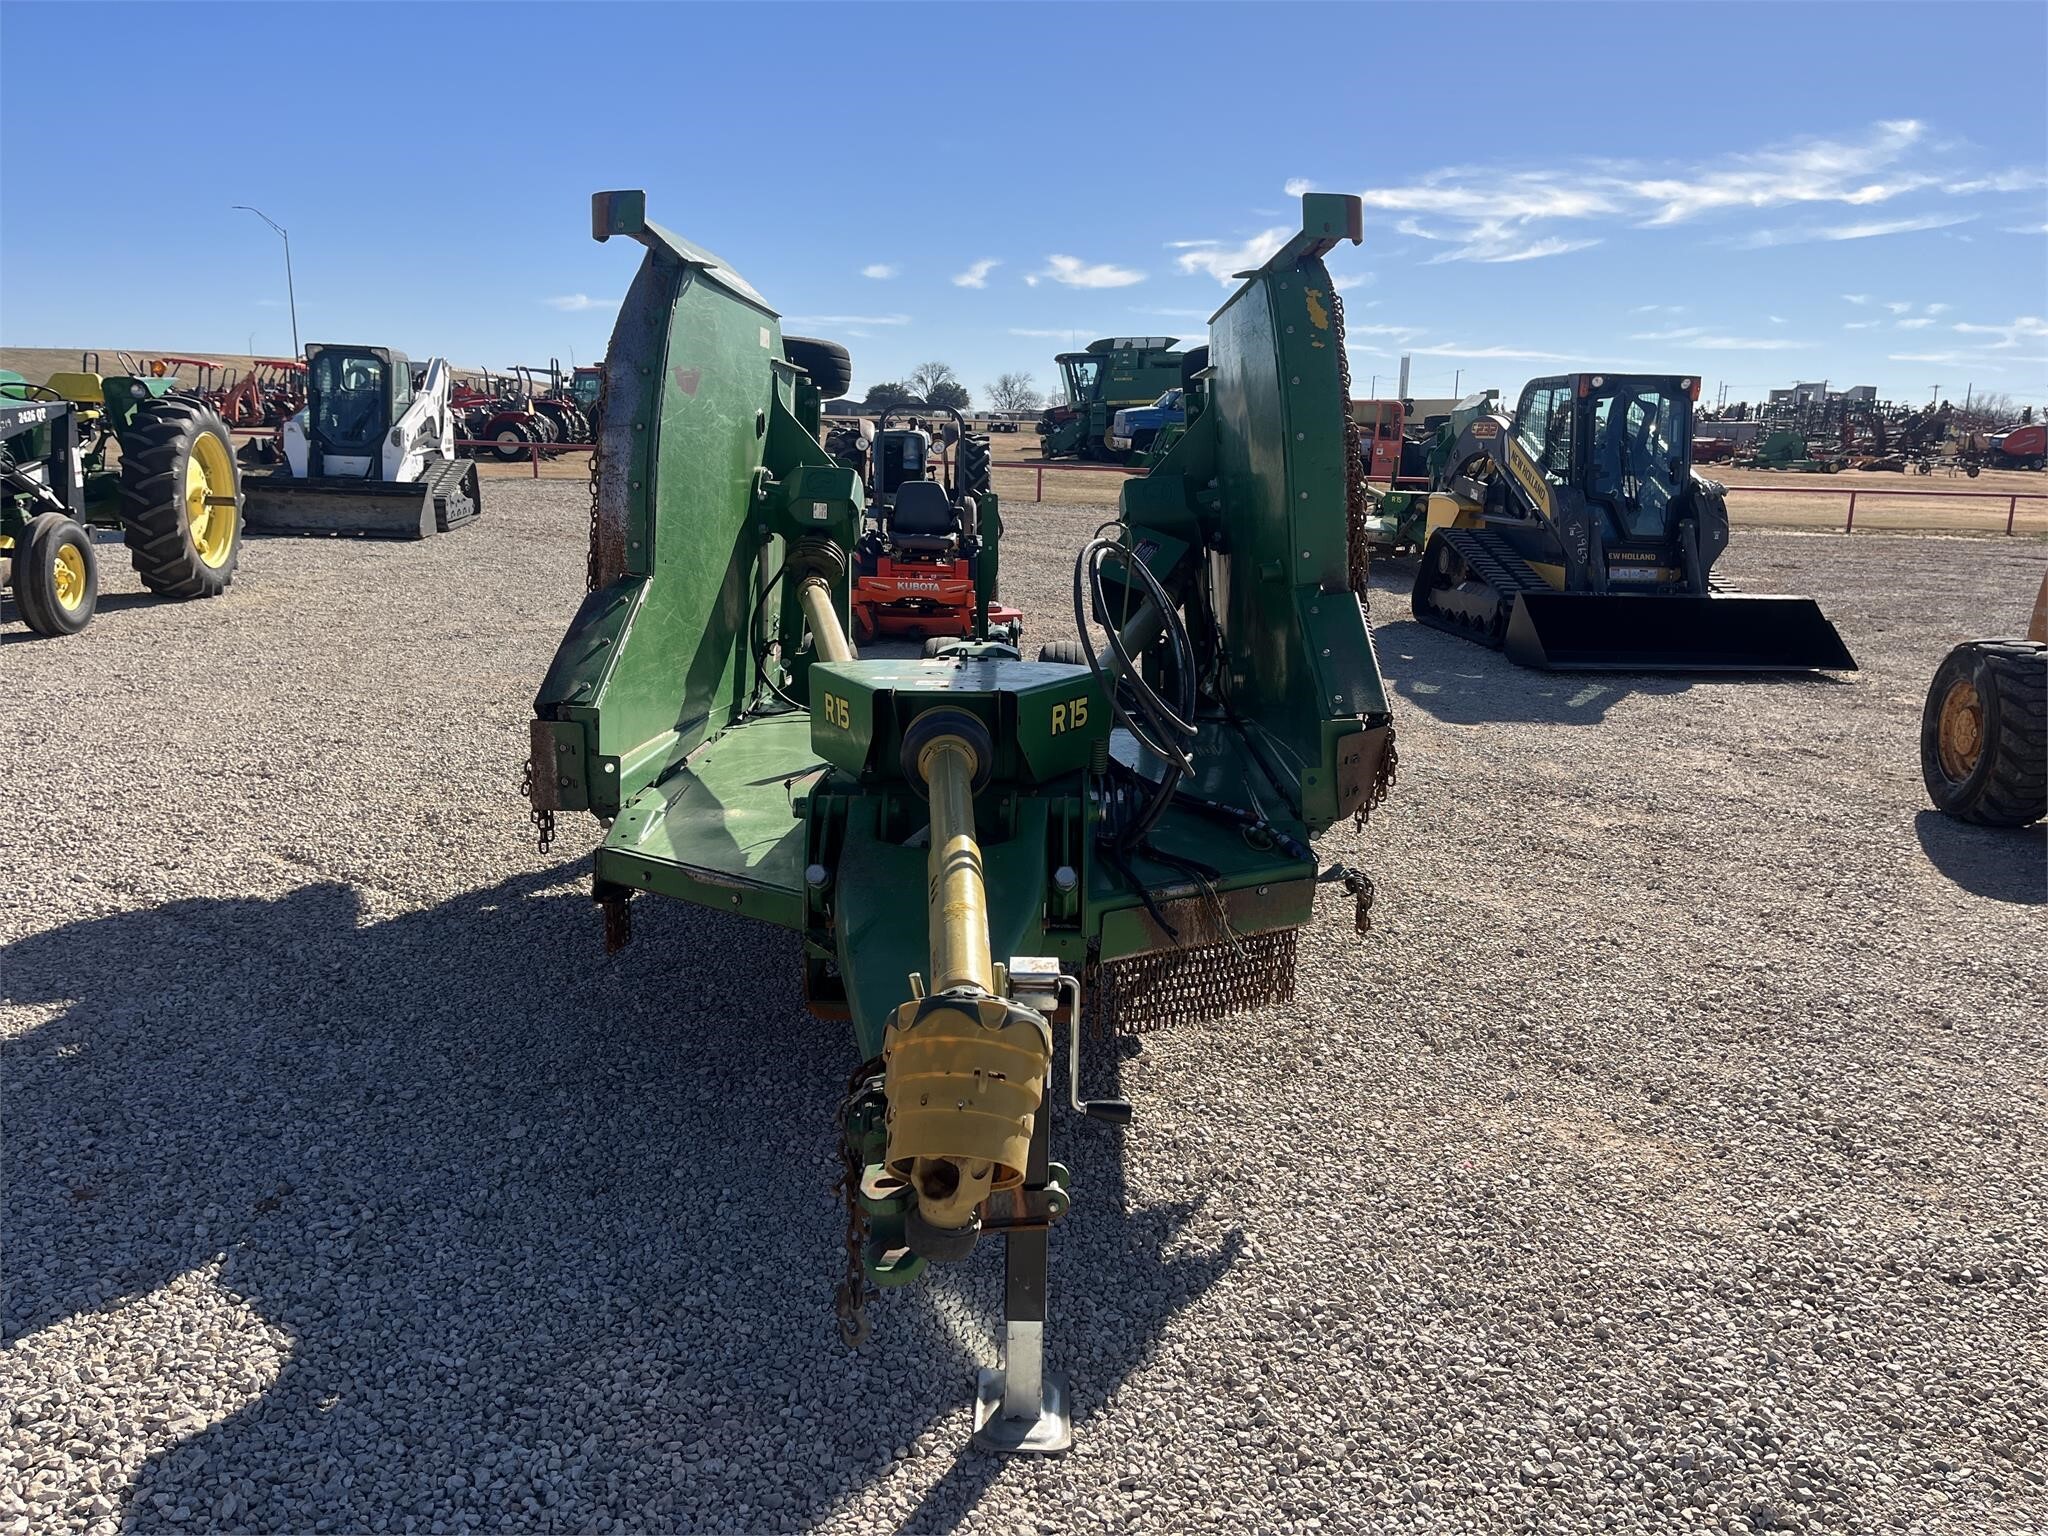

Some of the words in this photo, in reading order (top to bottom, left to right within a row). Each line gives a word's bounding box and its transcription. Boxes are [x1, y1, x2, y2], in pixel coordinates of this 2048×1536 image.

[18, 409, 36, 424] 2426
[36, 407, 47, 422] QT
[1522, 465, 1546, 500] HOLLAND
[1621, 552, 1657, 561] HOLLAND
[897, 581, 940, 592] KUBOTA
